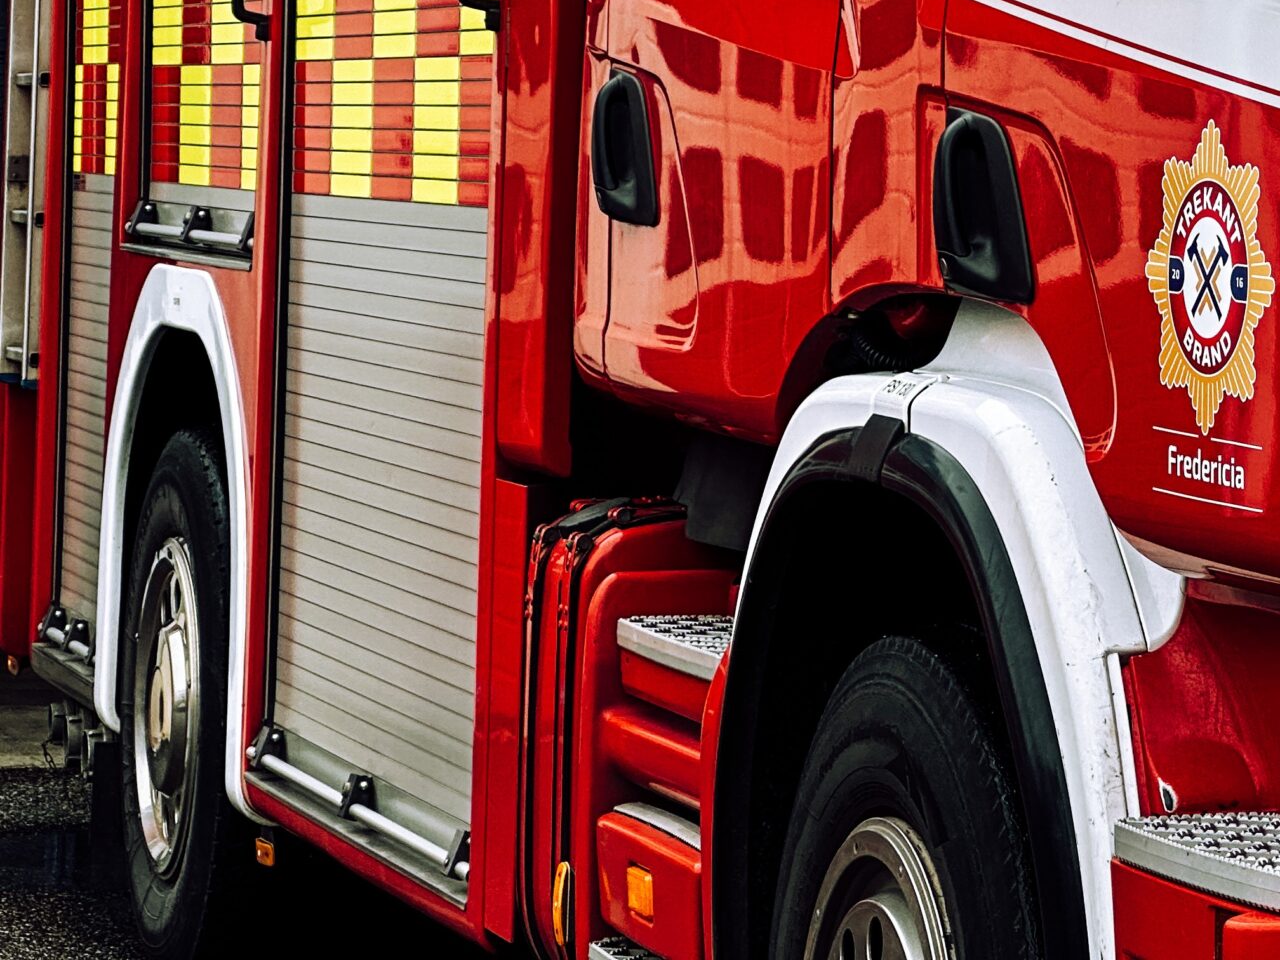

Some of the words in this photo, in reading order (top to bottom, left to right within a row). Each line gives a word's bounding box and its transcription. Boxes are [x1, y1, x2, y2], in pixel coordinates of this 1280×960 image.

[1176, 186, 1242, 244] TREKANT
[1171, 268, 1181, 280] 20
[1235, 276, 1244, 289] 16
[1183, 326, 1231, 368] BRAND
[1167, 444, 1245, 490] Fredericia
